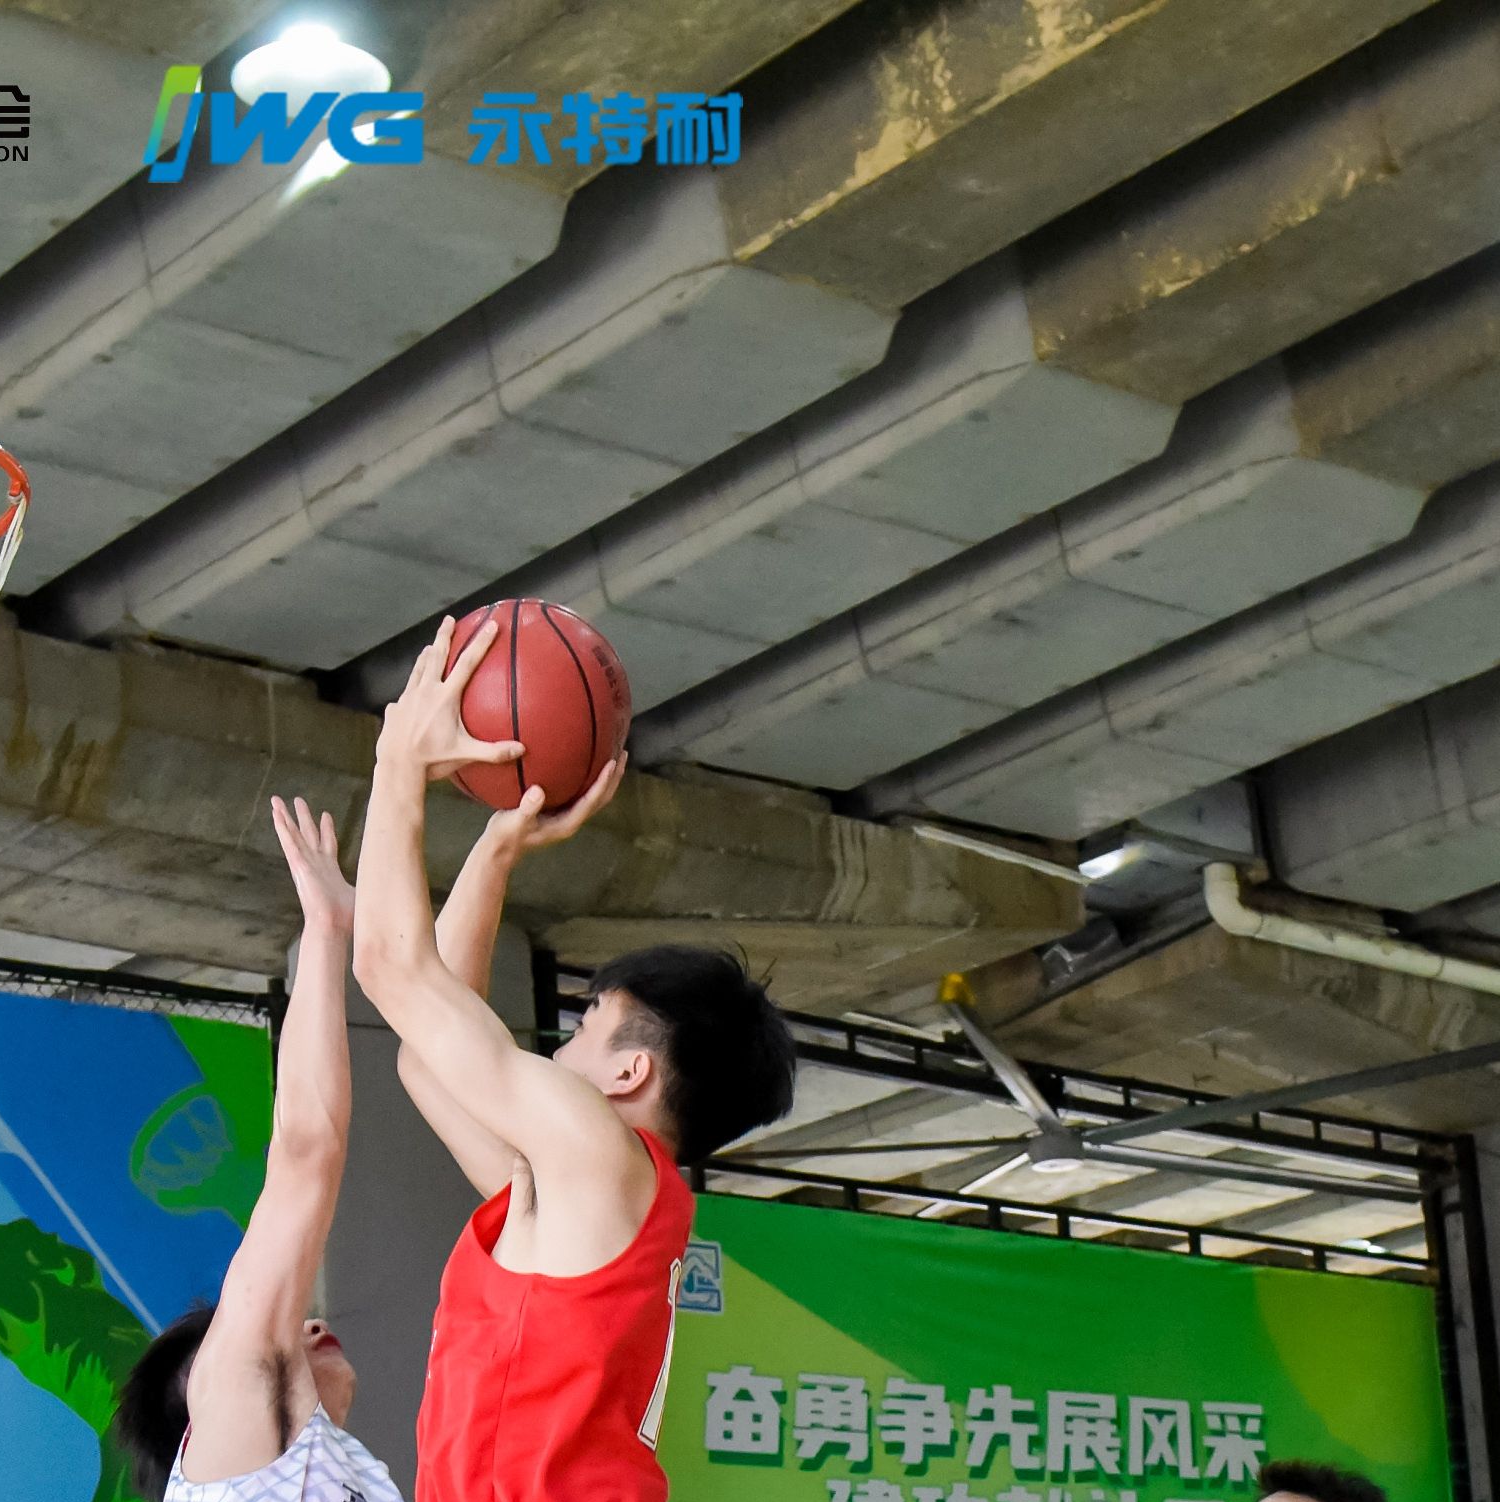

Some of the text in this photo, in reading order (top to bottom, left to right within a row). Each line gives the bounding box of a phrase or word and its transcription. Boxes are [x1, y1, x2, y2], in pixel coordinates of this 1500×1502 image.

[704, 1366, 1269, 1482] 奋勇争先展风采
